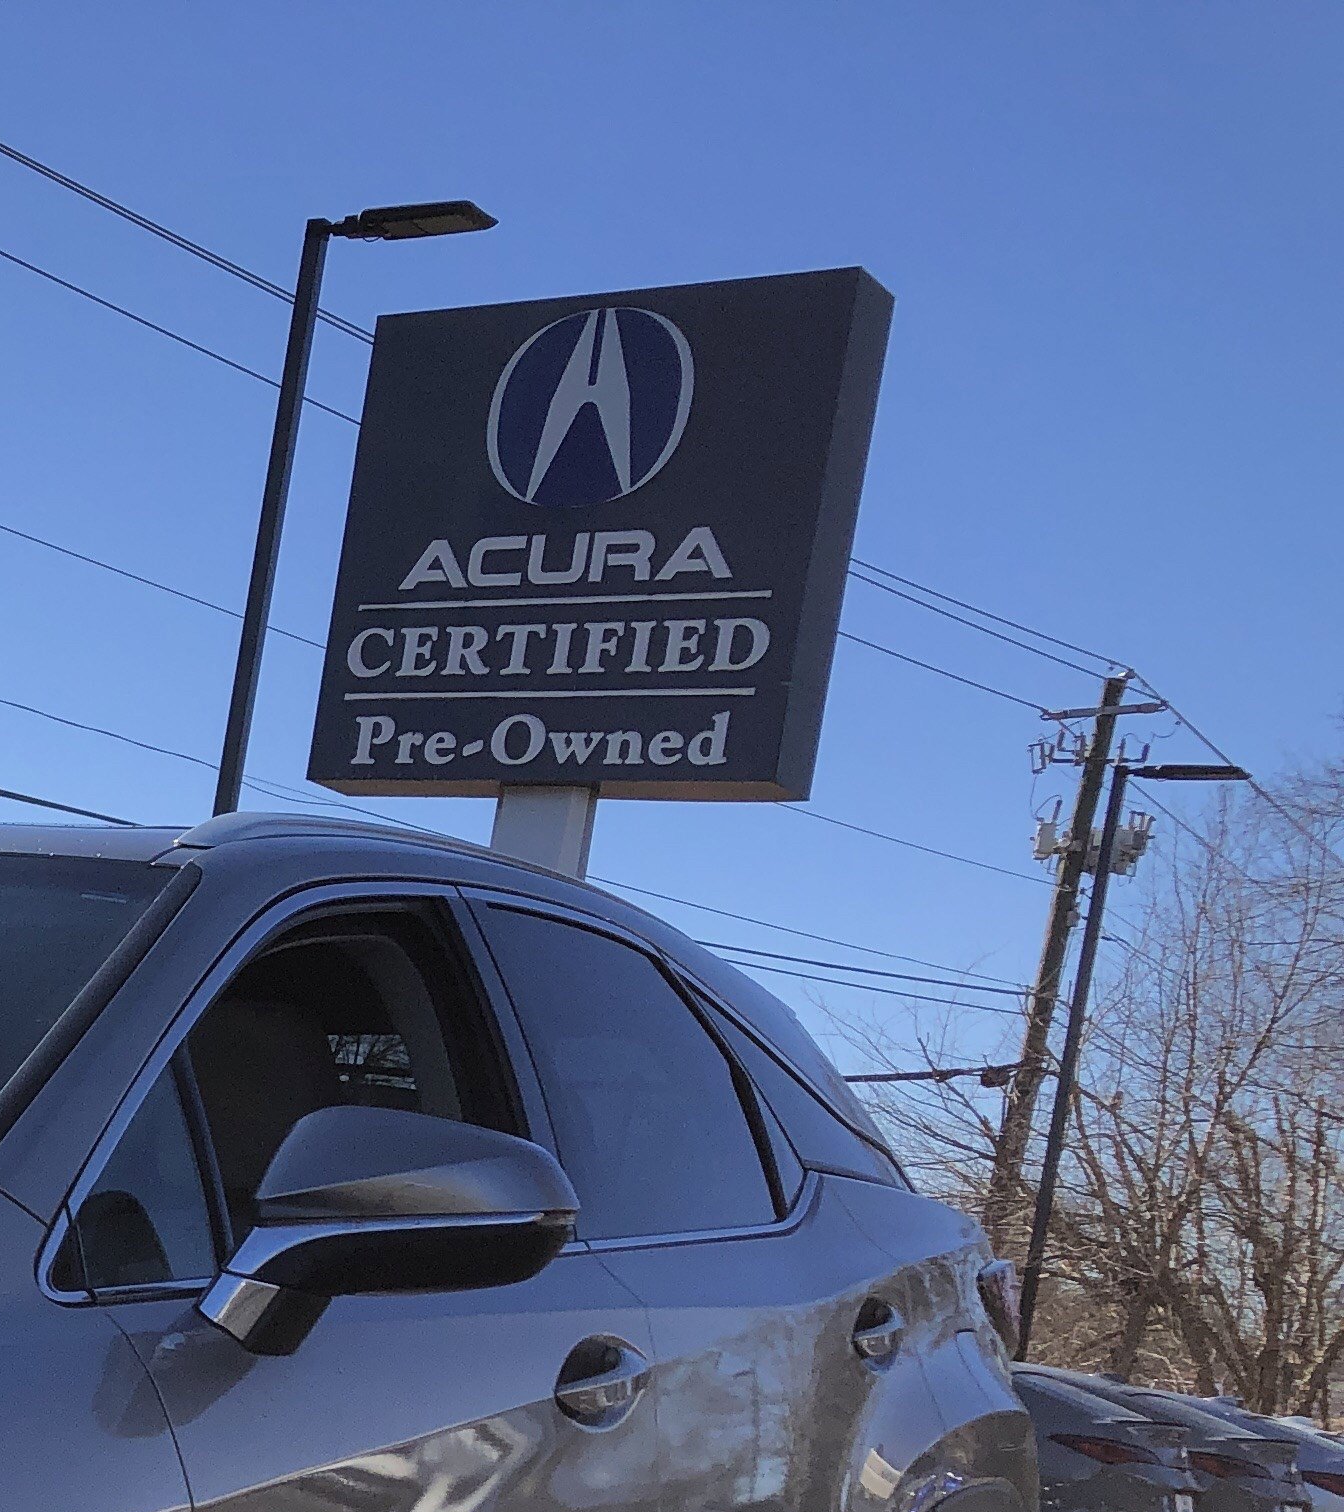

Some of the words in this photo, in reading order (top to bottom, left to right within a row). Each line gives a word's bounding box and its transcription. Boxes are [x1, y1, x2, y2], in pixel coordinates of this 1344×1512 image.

[398, 526, 733, 590] ACURA
[347, 617, 771, 680] CERTIFIED
[349, 711, 733, 768] Pre-Owned
